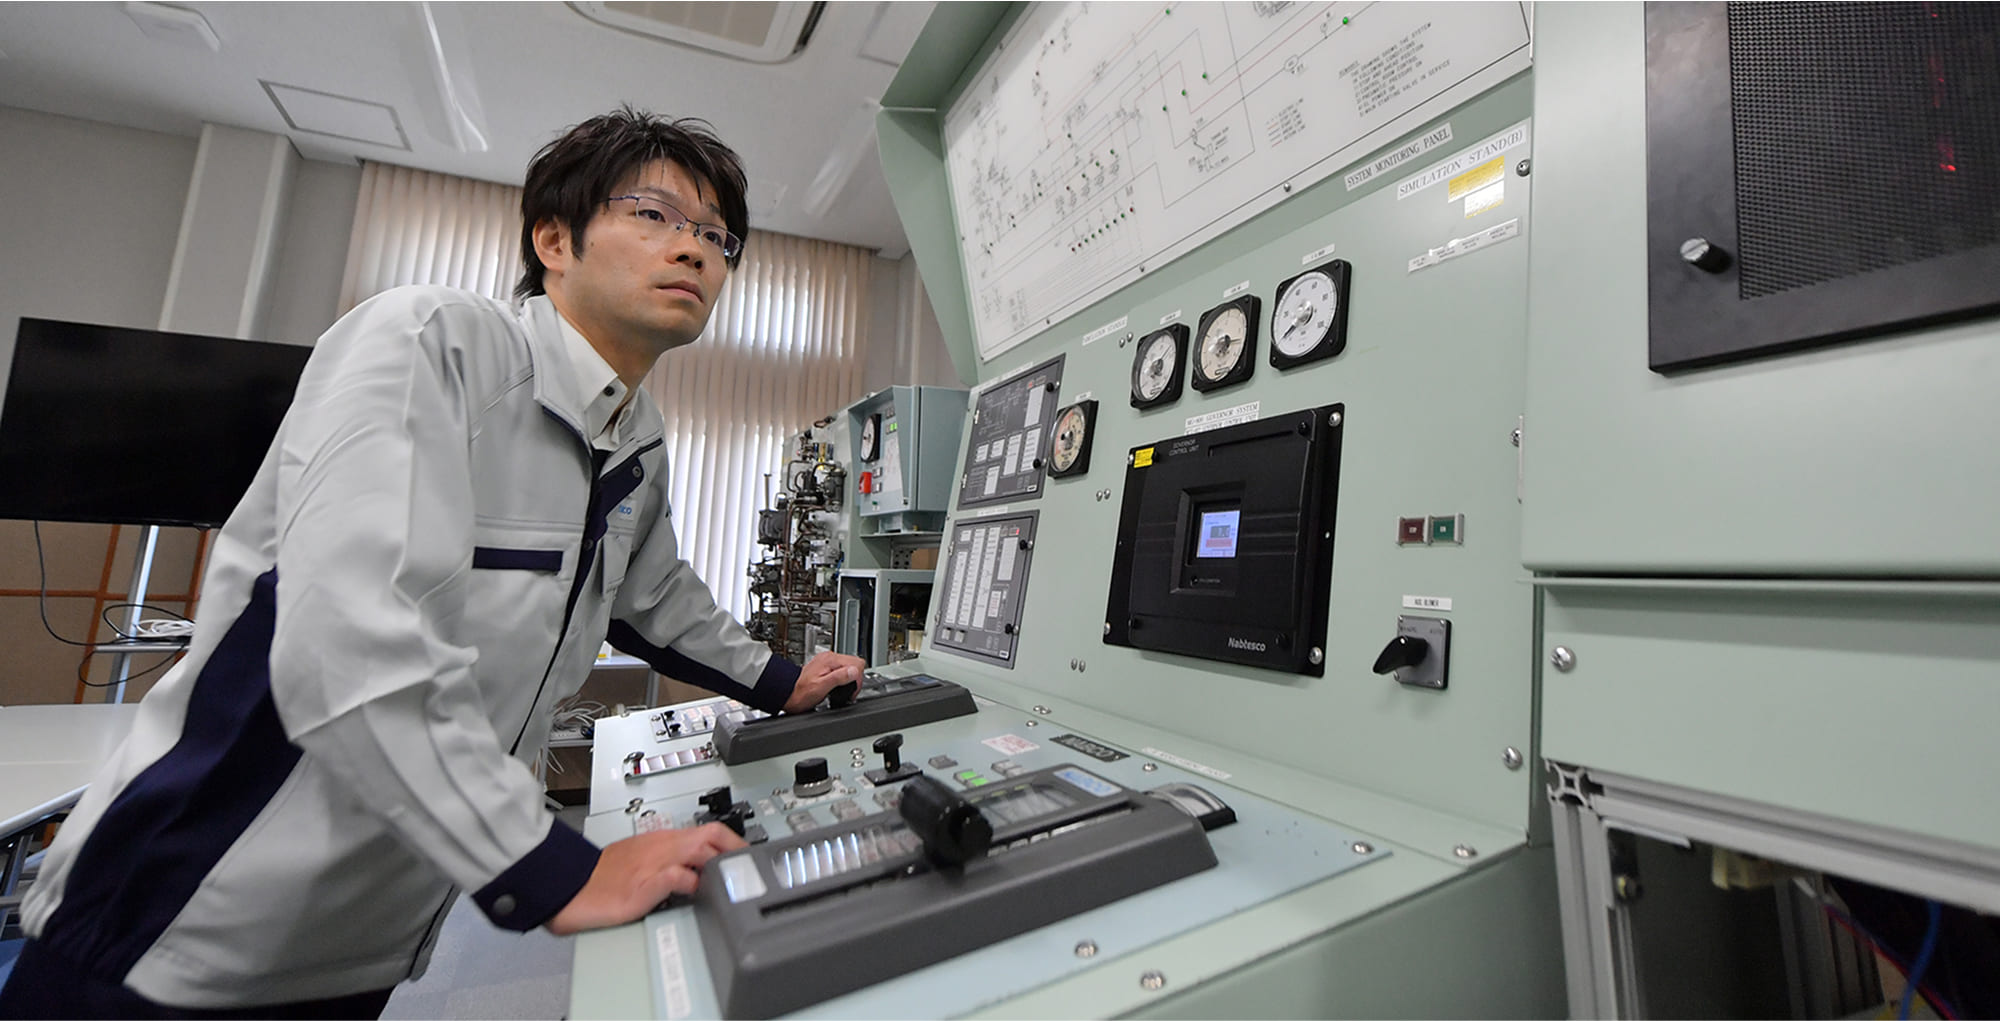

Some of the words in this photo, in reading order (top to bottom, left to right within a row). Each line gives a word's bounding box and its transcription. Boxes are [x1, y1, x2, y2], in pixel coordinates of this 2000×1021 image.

[1347, 165, 1373, 187] SYSTEM
[1375, 143, 1420, 175] MONITORING
[1423, 127, 1451, 149] PANEL
[1399, 158, 1464, 196] SIMULATION
[1468, 129, 1523, 165] STAND(B)
[1227, 636, 1266, 652] Nabtesco
